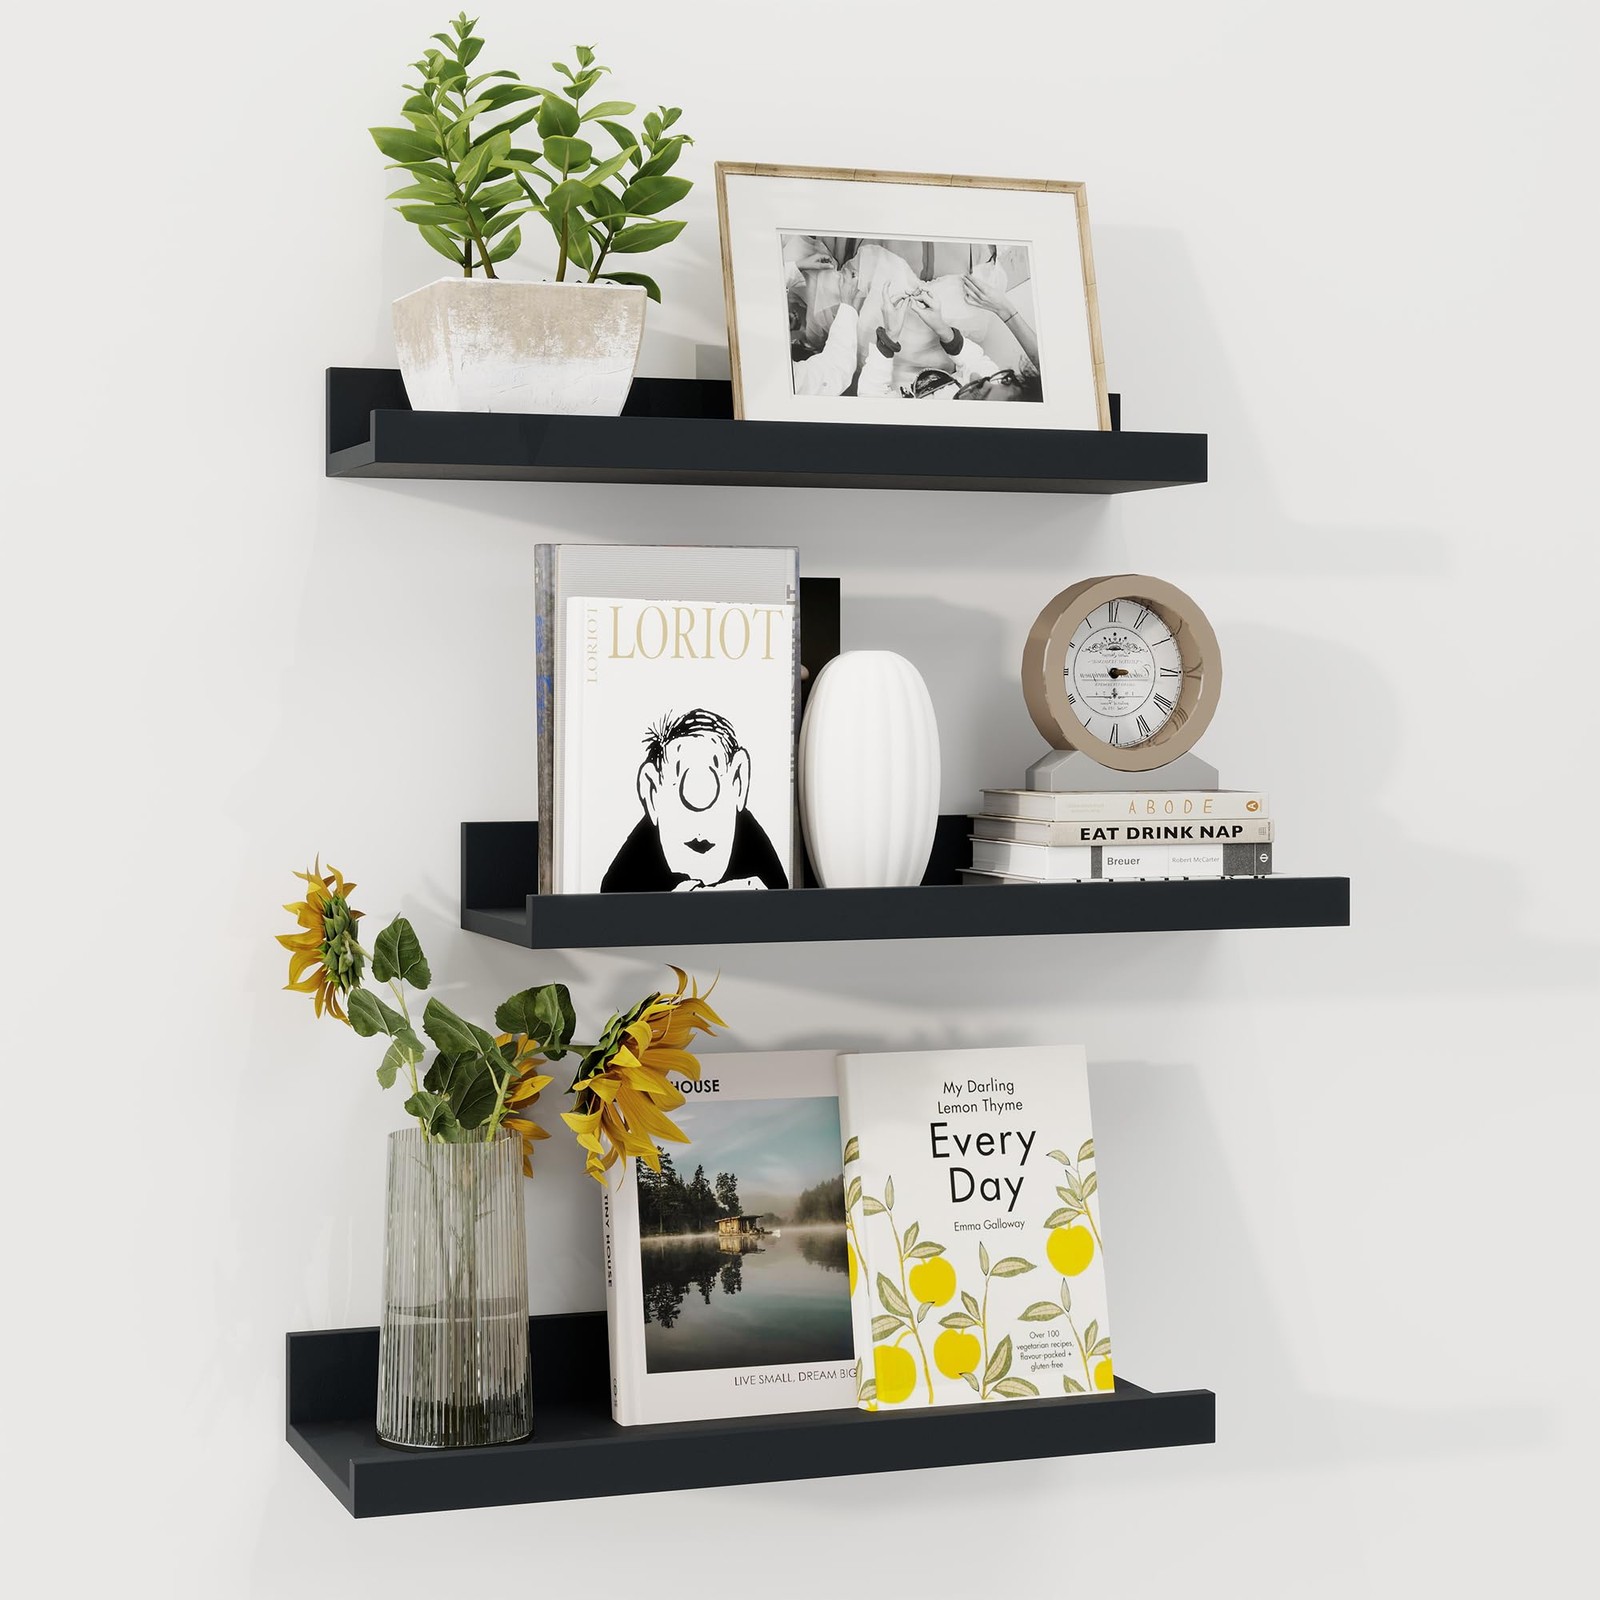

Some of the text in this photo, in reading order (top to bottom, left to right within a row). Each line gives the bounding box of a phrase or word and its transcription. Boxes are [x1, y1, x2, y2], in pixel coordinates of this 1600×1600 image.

[607, 605, 785, 660] LORIOT
[586, 603, 598, 683] LORIOT
[1080, 825, 1243, 841] EAT DRINK NAP
[1107, 857, 1141, 866] Breuer
[943, 1078, 1015, 1098] My Darling
[938, 1099, 1023, 1116] Lemon Thyme
[930, 1122, 1037, 1166] Every
[950, 1167, 1024, 1213] Day
[954, 1218, 1026, 1232] Emma Galloway
[1029, 1329, 1060, 1339] Over 100
[1016, 1343, 1049, 1352] vegetarian
[734, 1368, 857, 1386] LIVE SMALL, DREAM BIG
